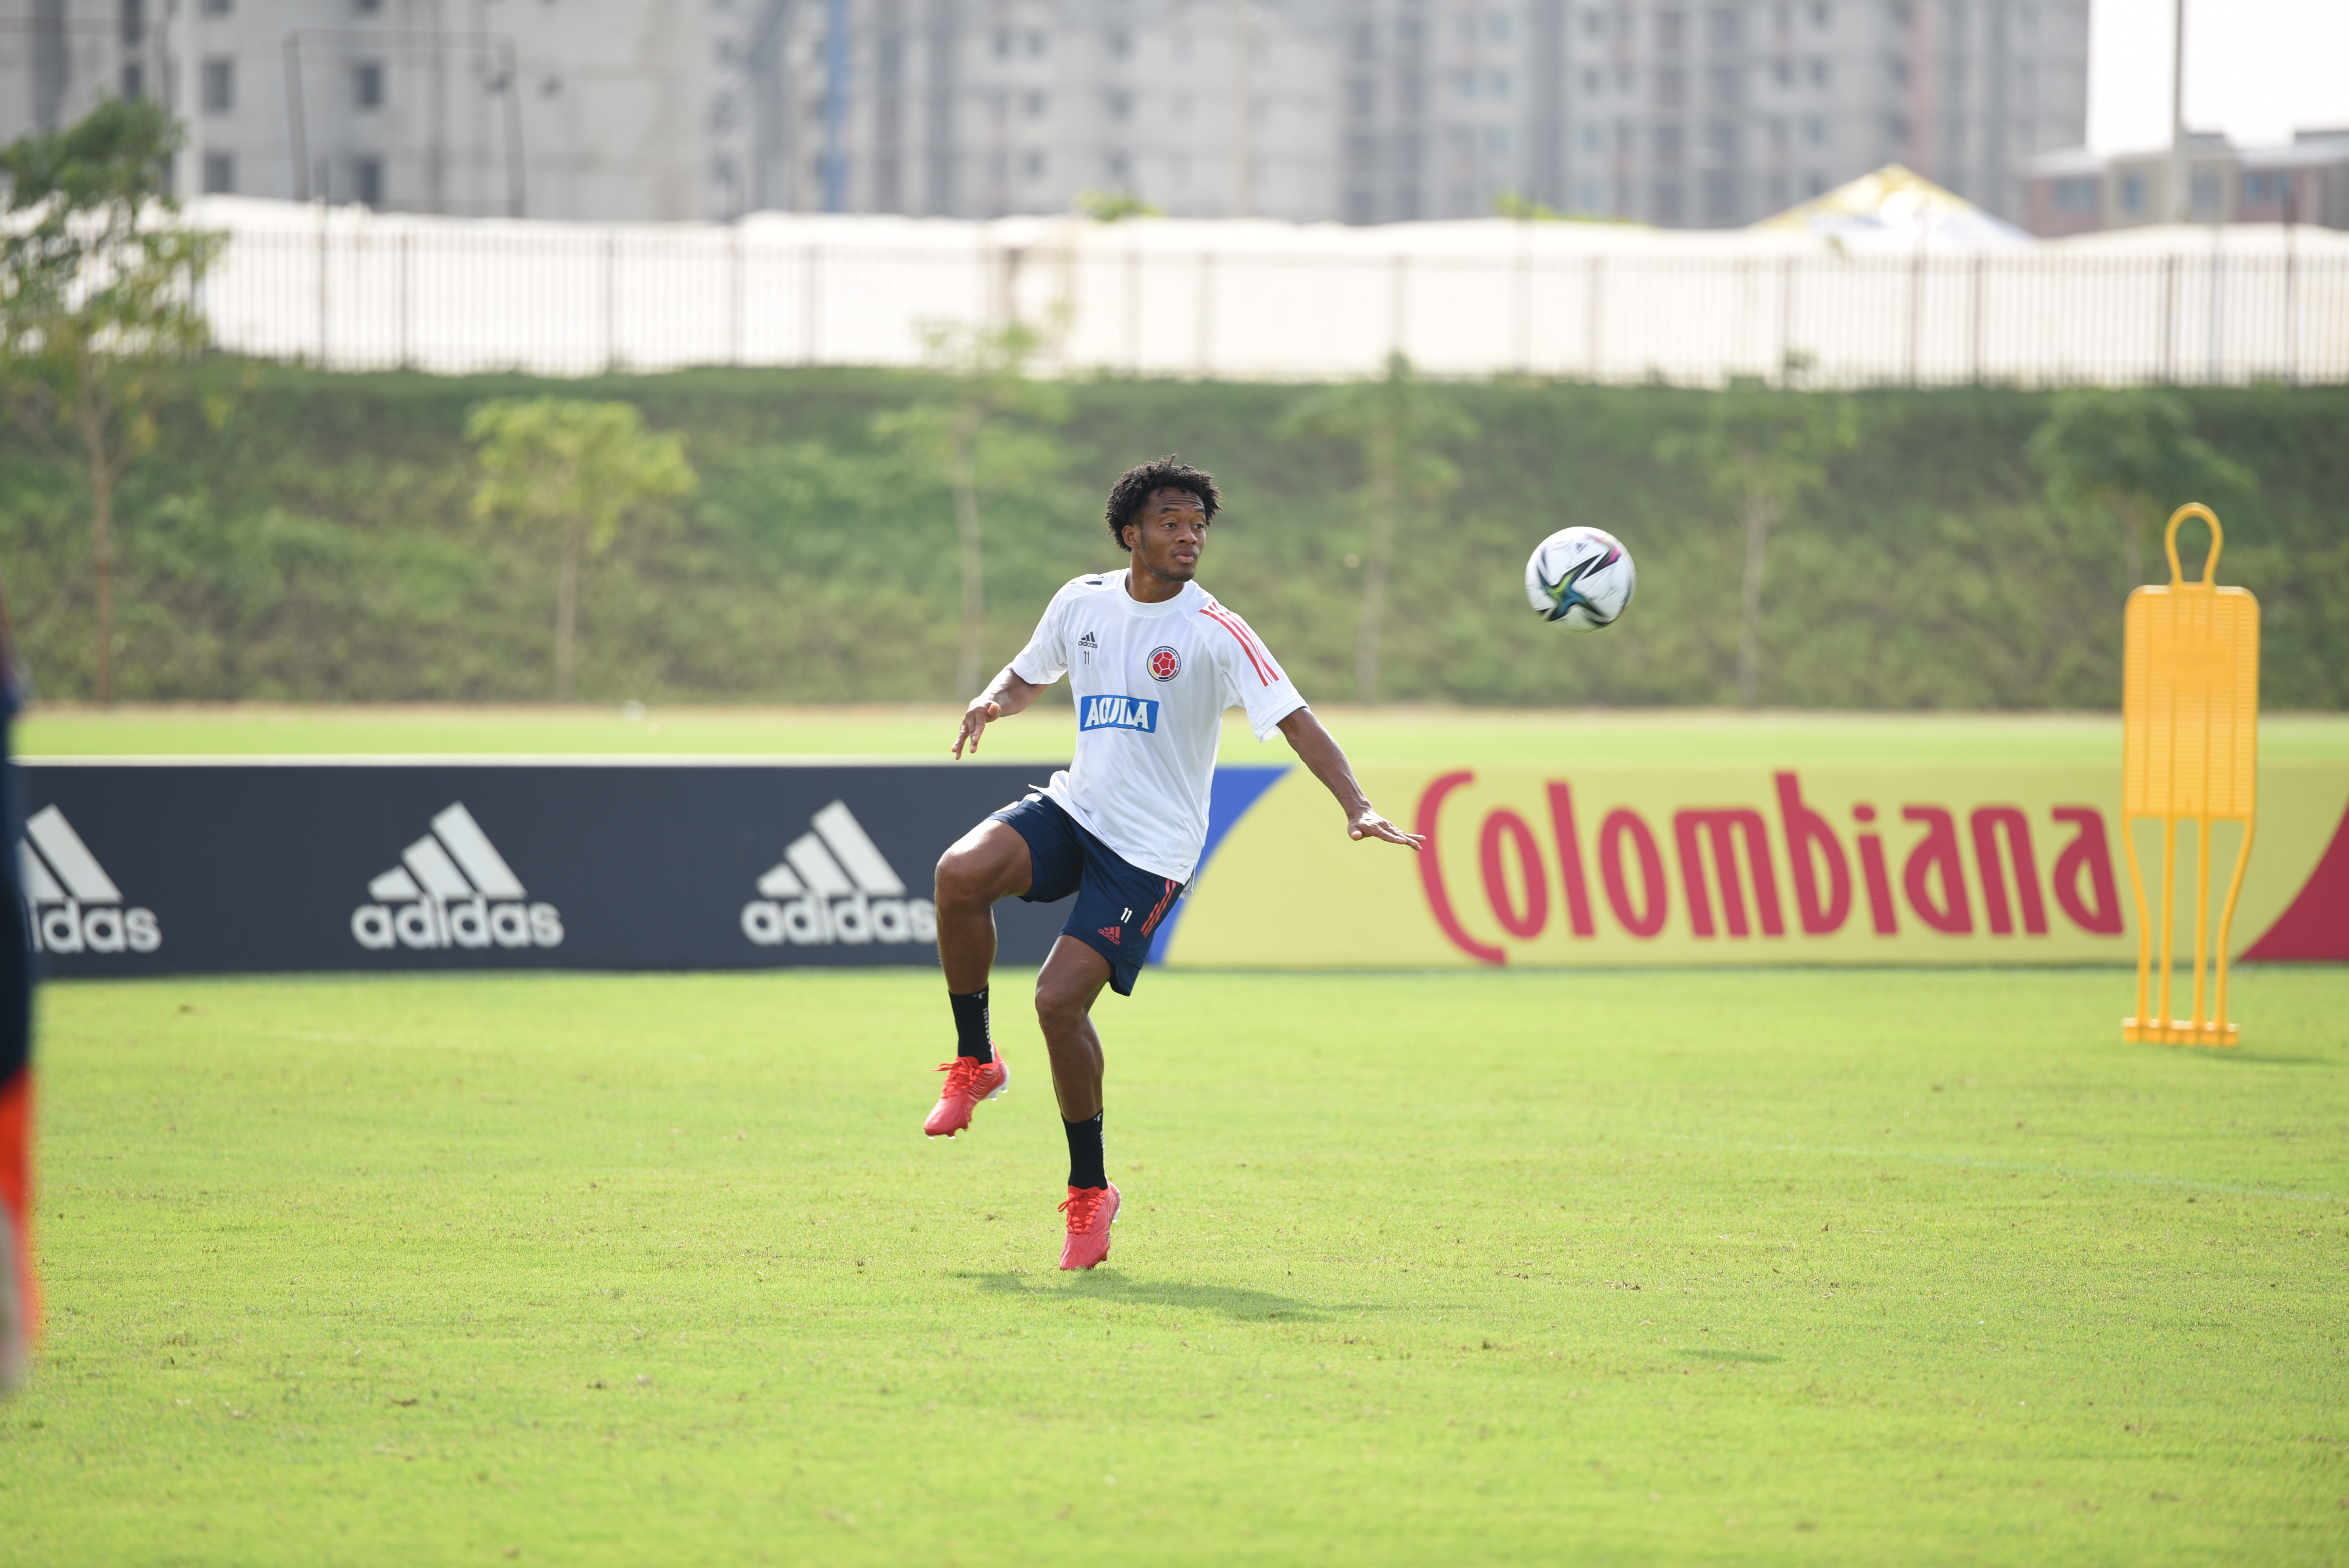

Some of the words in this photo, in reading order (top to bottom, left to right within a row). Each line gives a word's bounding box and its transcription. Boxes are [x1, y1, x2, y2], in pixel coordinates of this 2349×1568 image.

[1078, 640, 1098, 649] addas
[1084, 650, 1089, 665] 11
[1084, 697, 1150, 729] AGUILA
[1415, 769, 2123, 966] Colombiana
[24, 896, 162, 953] idas
[351, 892, 565, 950] adidas
[741, 890, 937, 945] adidas
[1120, 907, 1132, 923] 11
[1098, 928, 1121, 946] adidas
